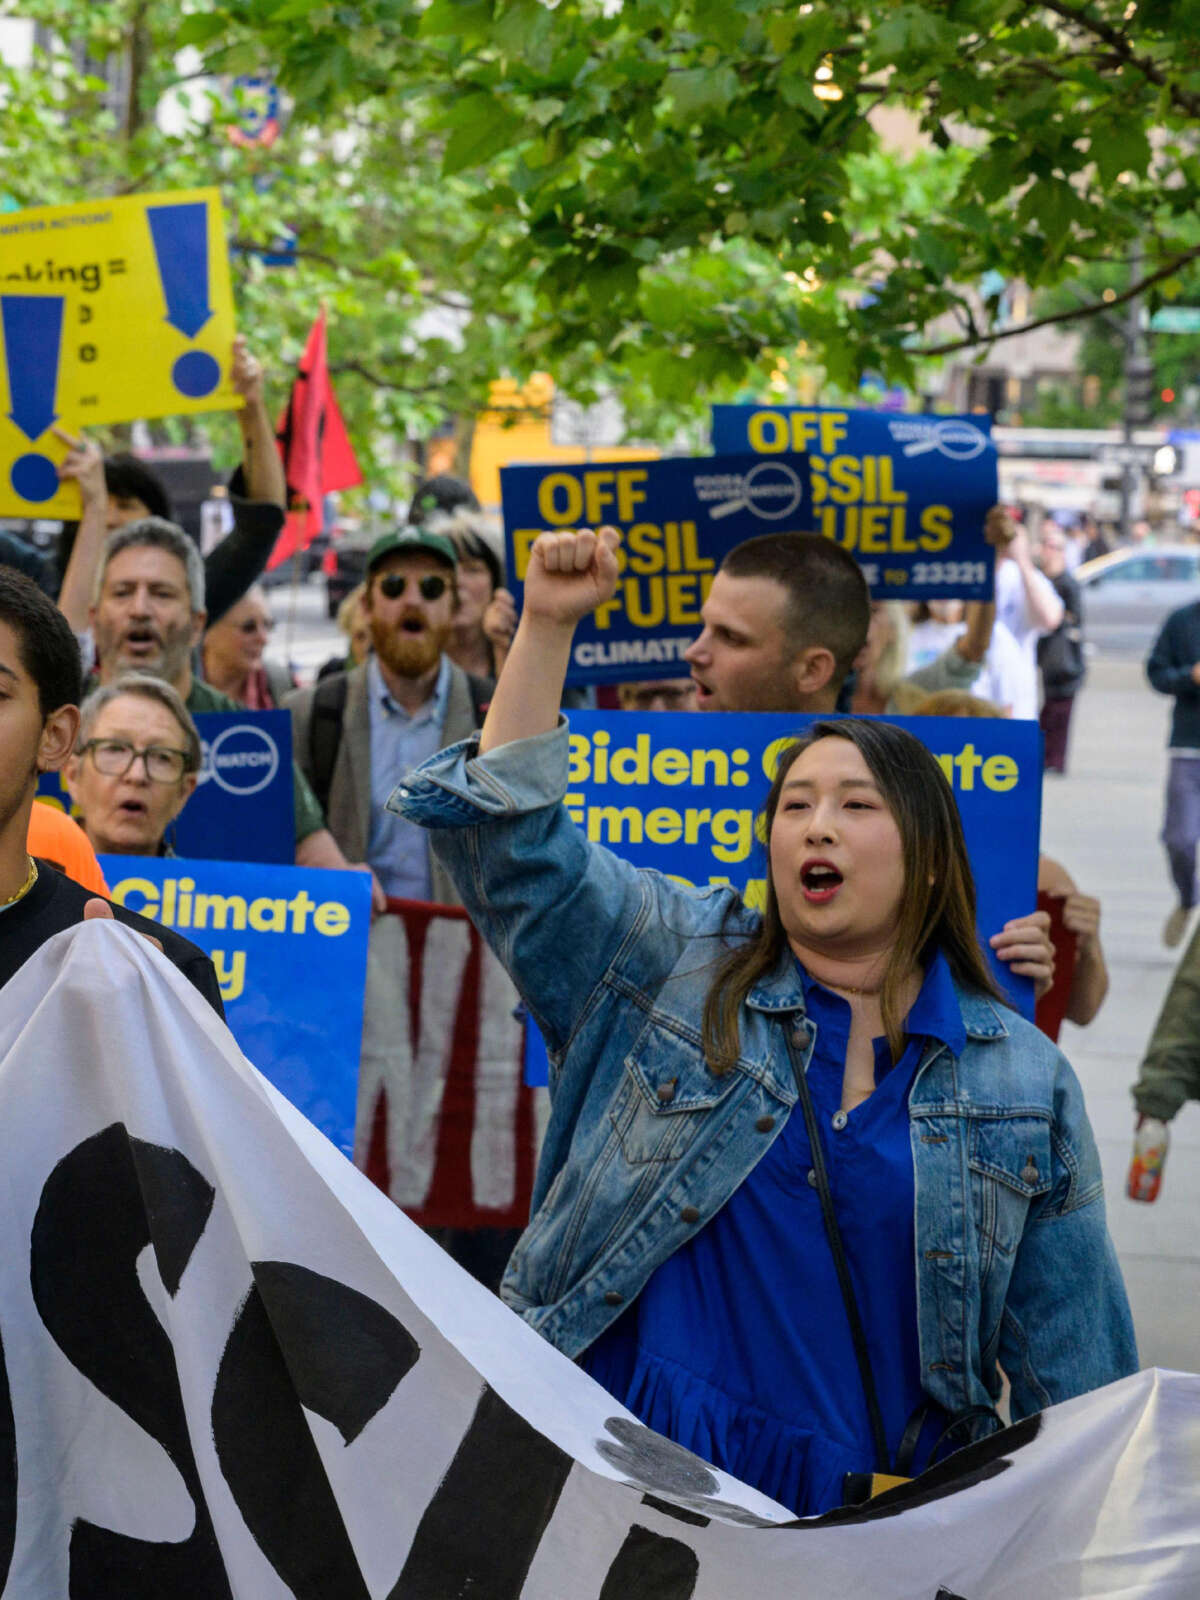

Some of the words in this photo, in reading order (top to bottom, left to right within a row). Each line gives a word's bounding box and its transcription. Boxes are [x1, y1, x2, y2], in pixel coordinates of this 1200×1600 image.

[747, 411, 849, 454] OFF
[538, 470, 648, 526] OFF
[809, 455, 909, 504] SSIL
[513, 521, 716, 581] FSIL
[813, 504, 954, 553] UELS
[216, 752, 272, 769] WATCH
[110, 877, 351, 937] Climate
